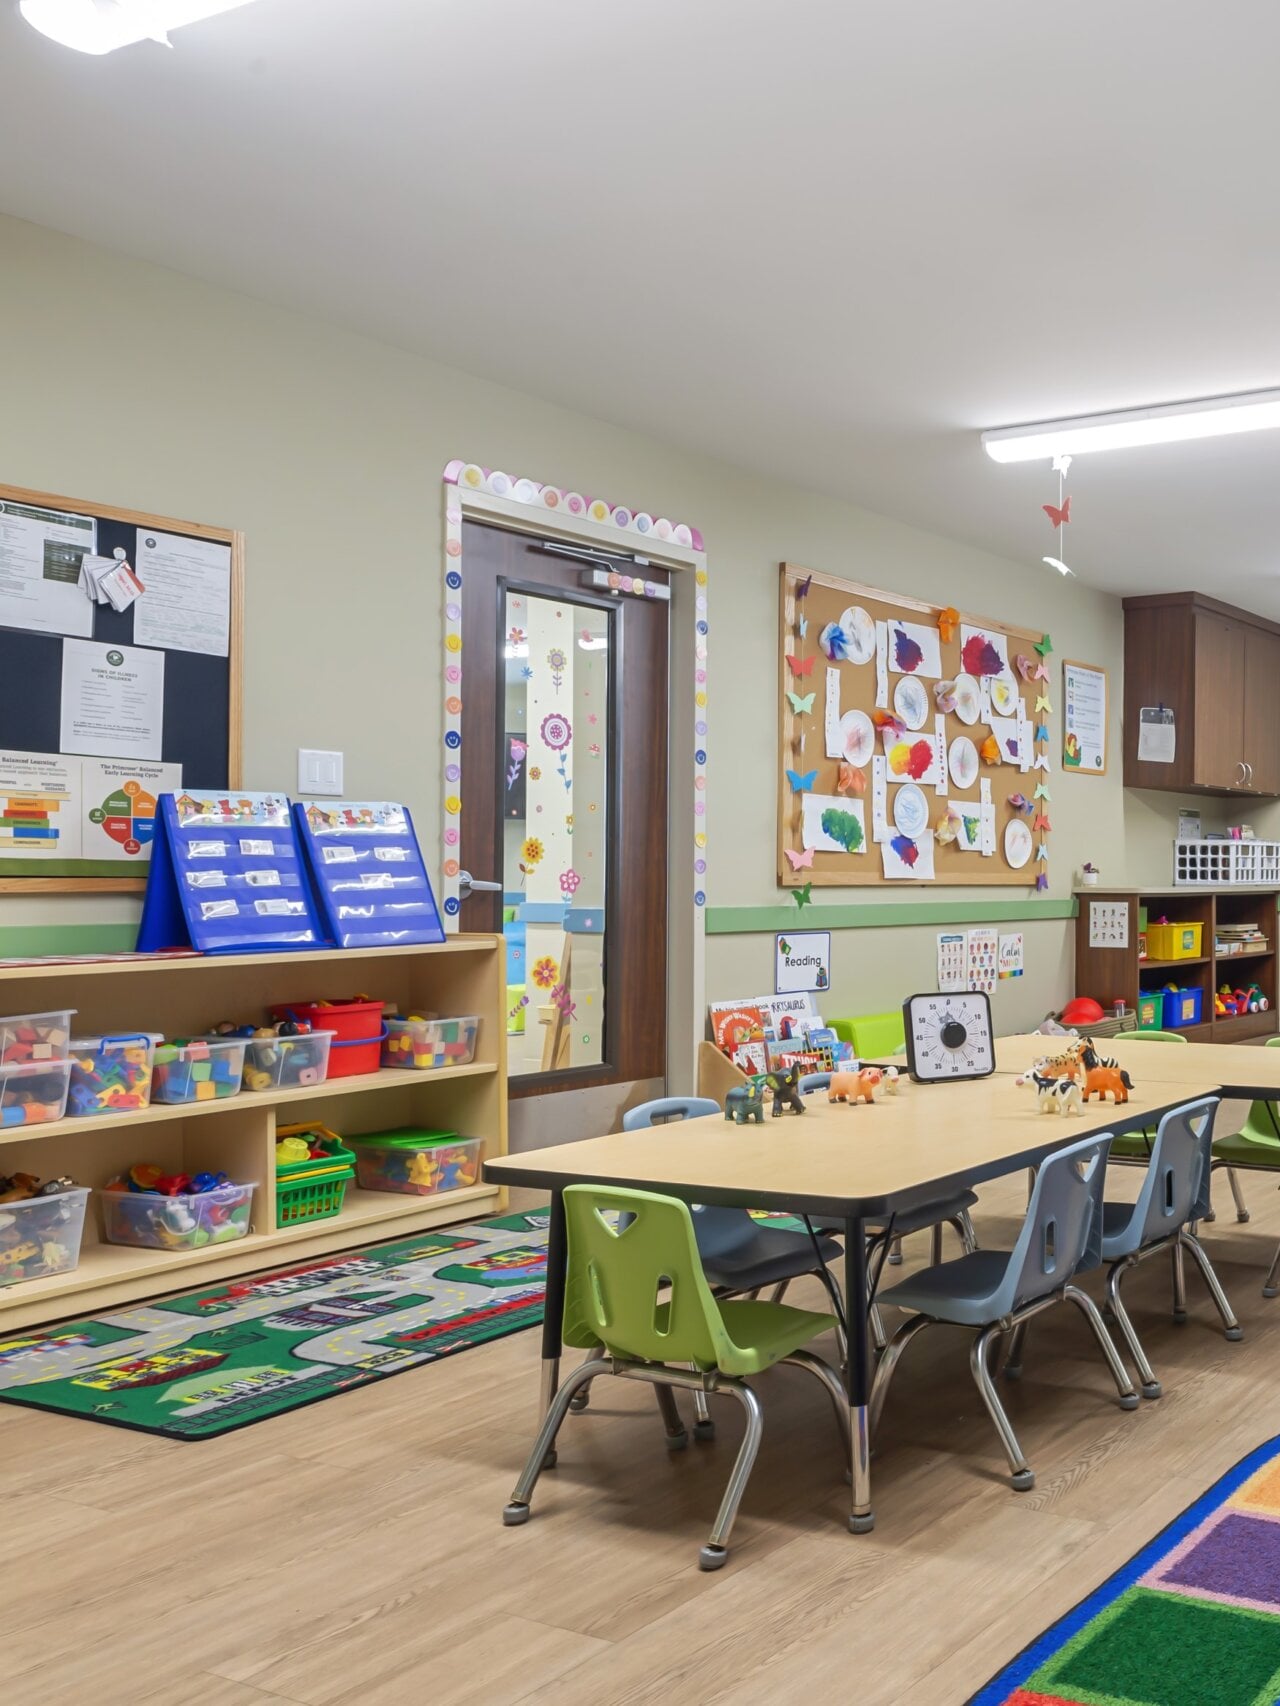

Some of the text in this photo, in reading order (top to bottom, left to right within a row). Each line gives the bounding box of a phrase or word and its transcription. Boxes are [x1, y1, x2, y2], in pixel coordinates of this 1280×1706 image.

[785, 955, 821, 968] Reading
[946, 998, 951, 1006] 0
[215, 1375, 298, 1402] DEPOT
